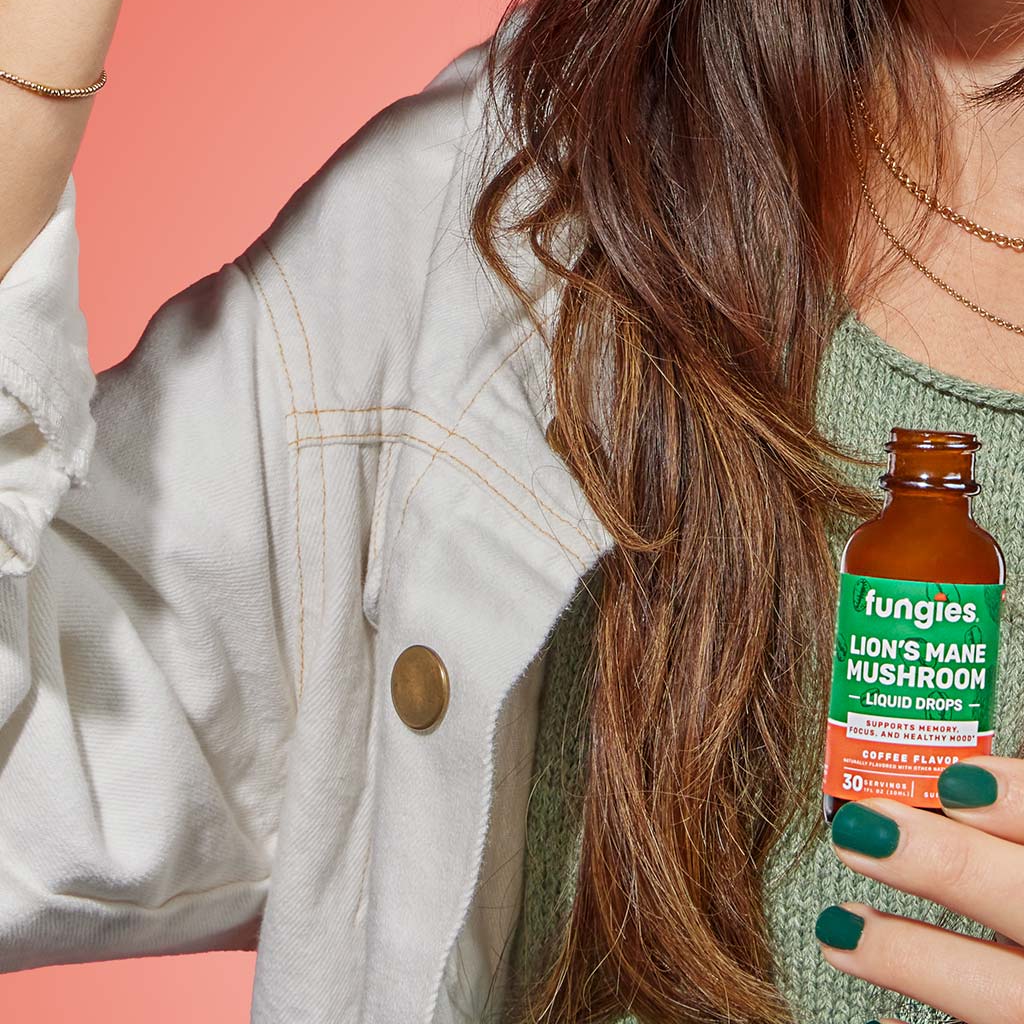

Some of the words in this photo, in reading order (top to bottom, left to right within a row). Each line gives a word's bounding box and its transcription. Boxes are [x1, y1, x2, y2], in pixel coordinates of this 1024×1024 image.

[865, 589, 977, 629] fungies
[850, 634, 920, 662] LION'S
[925, 642, 987, 663] MANE
[847, 659, 986, 690] MUSHROOM
[865, 692, 912, 709] LIQUID
[915, 696, 963, 711] DROPS
[866, 719, 915, 731] SUPPORTS
[880, 730, 900, 739] AND
[903, 732, 947, 742] HEALTHY
[862, 749, 908, 763] COFFEE
[842, 772, 864, 792] 30
[864, 779, 907, 790] SERVINGS
